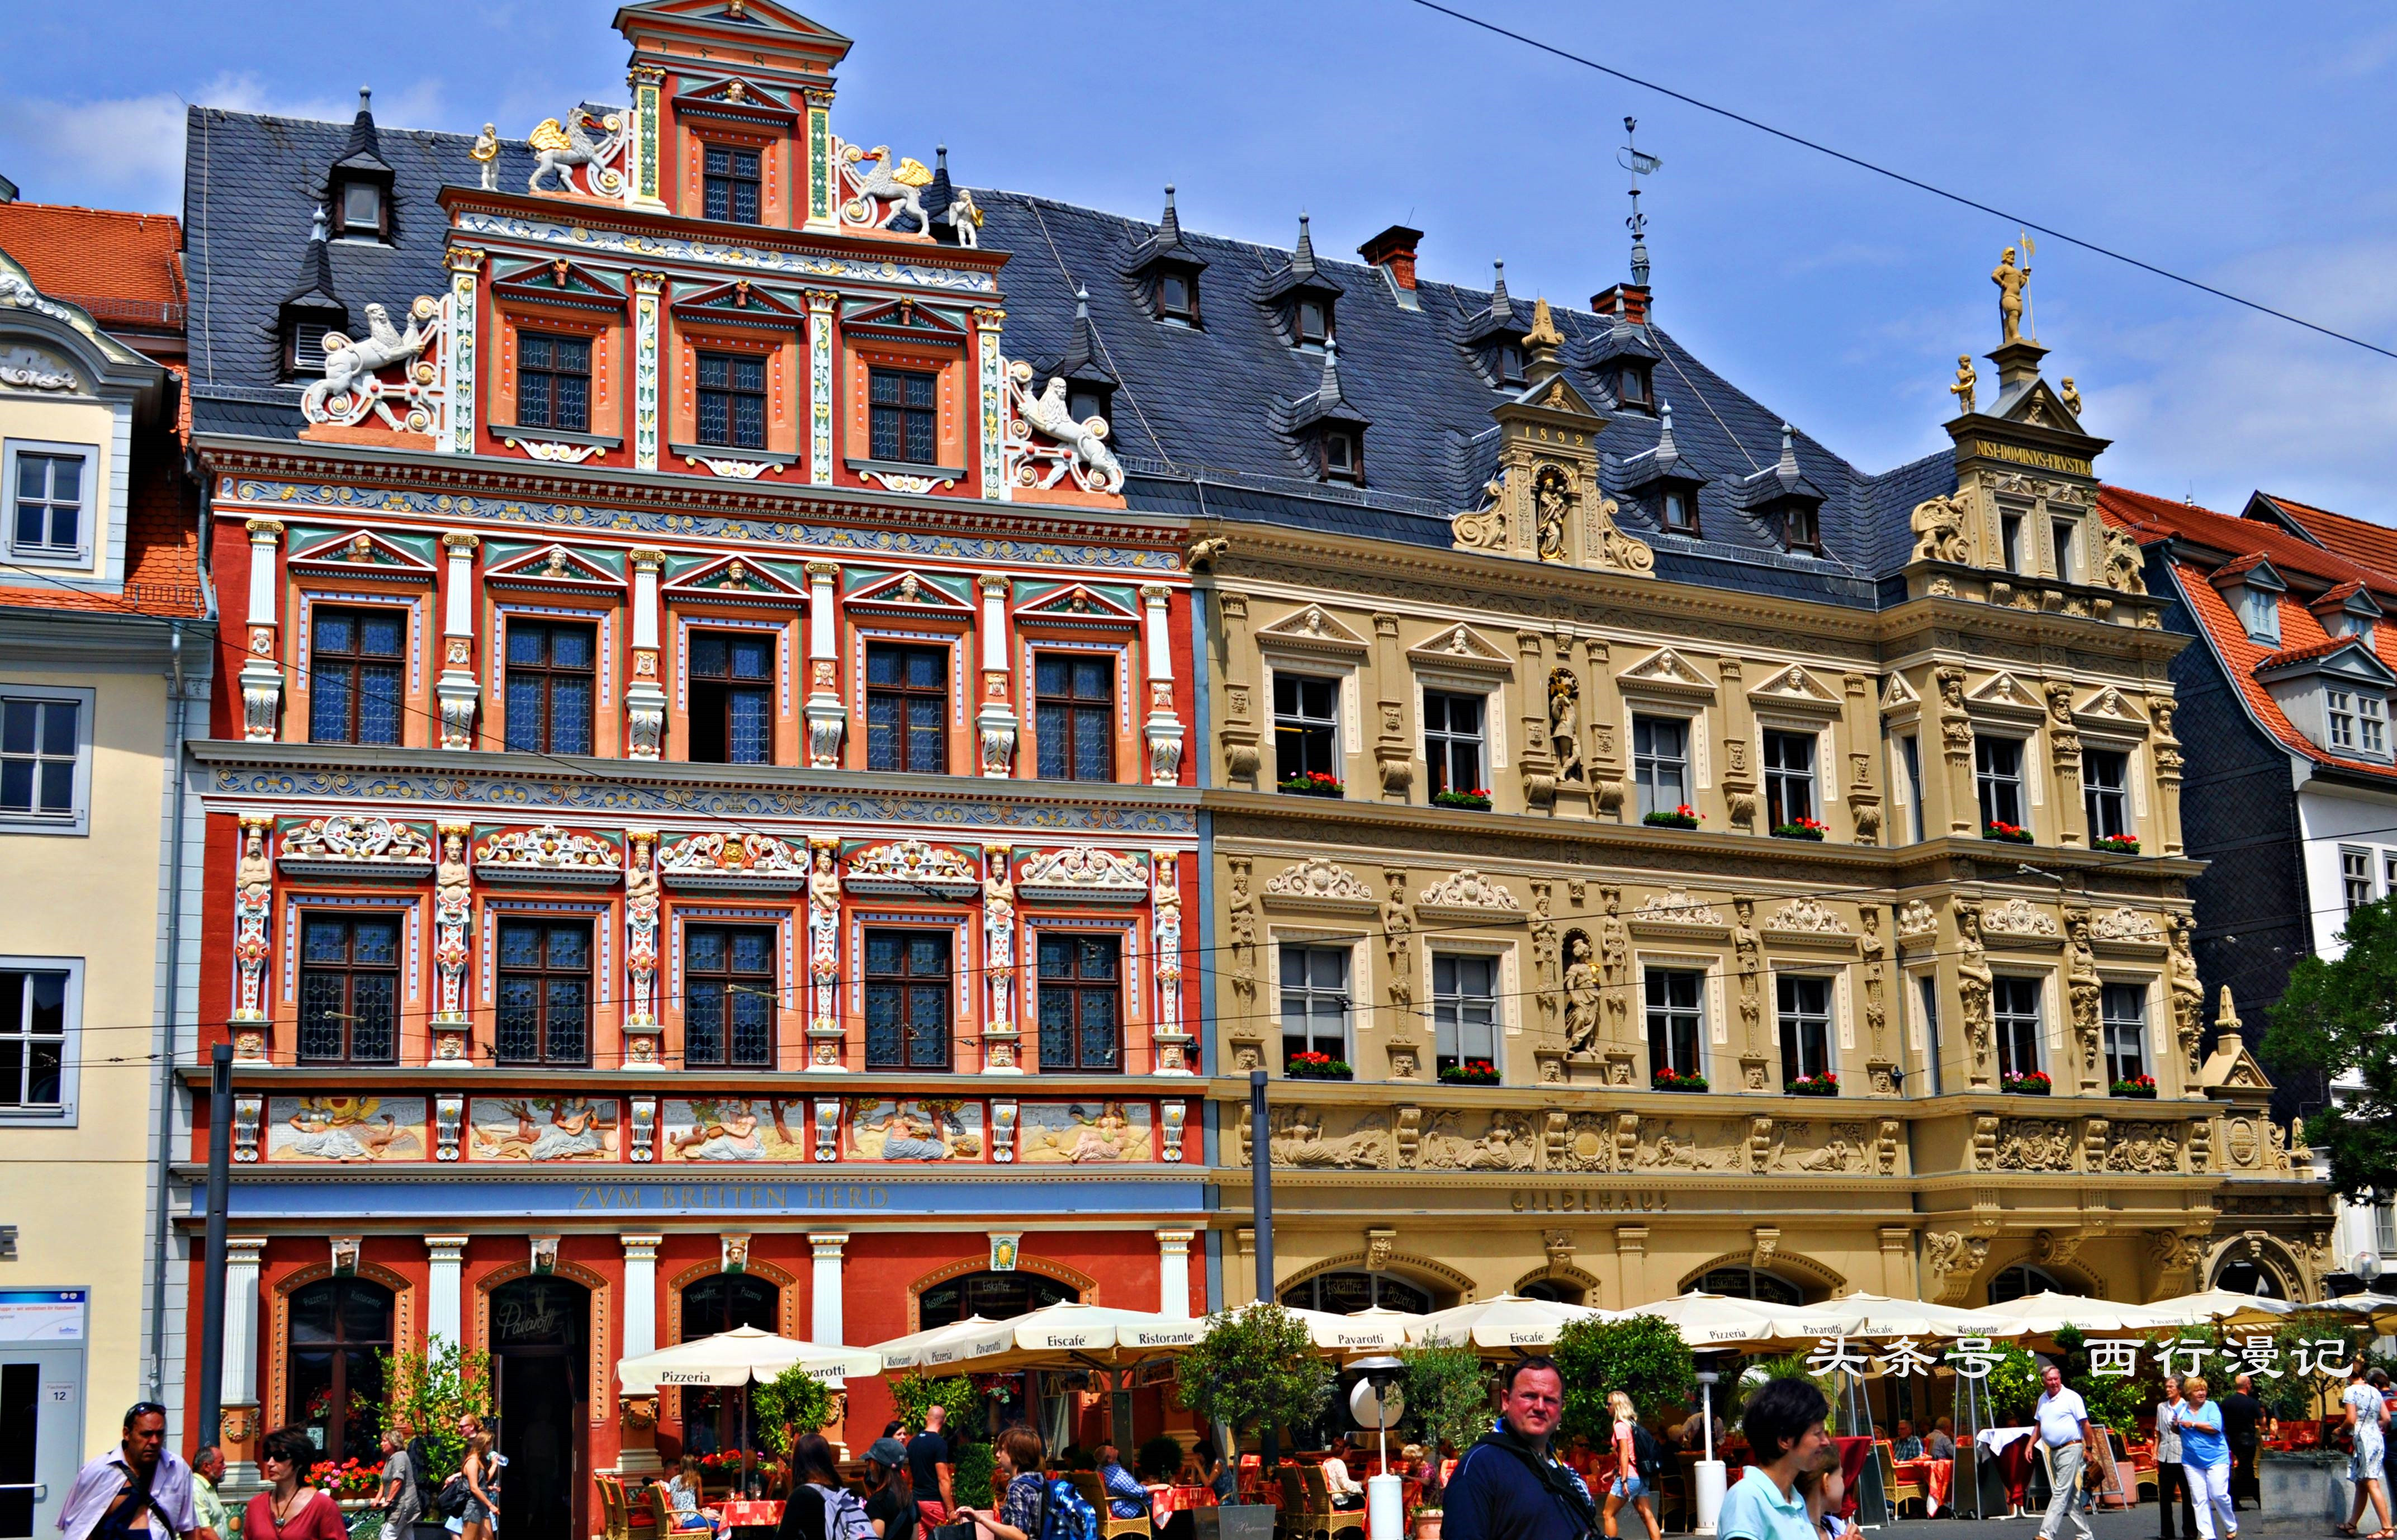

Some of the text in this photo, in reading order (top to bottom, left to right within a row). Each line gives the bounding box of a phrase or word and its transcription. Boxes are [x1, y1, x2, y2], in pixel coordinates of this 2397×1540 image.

[576, 1187, 889, 1209] ZVM BREITEN HERD
[982, 1281, 1010, 1292] Eiskaffee
[925, 1290, 957, 1309] Ristorante
[1040, 1288, 1062, 1304] Pizzeri
[1387, 1286, 1417, 1310] Pizzeria
[1709, 1329, 1747, 1340] Pizzeria
[1803, 1323, 1842, 1334] Pavarotti
[1958, 1325, 1998, 1334] Ristorante
[1139, 1332, 1195, 1344] Ristorante
[1338, 1333, 1385, 1344] Pavarotti
[976, 1339, 1001, 1354] Pavarotti
[887, 1355, 912, 1367] Ristorante
[932, 1349, 953, 1362] Pizzeria
[662, 1371, 710, 1383] Pizzeria
[54, 1391, 66, 1400] 12
